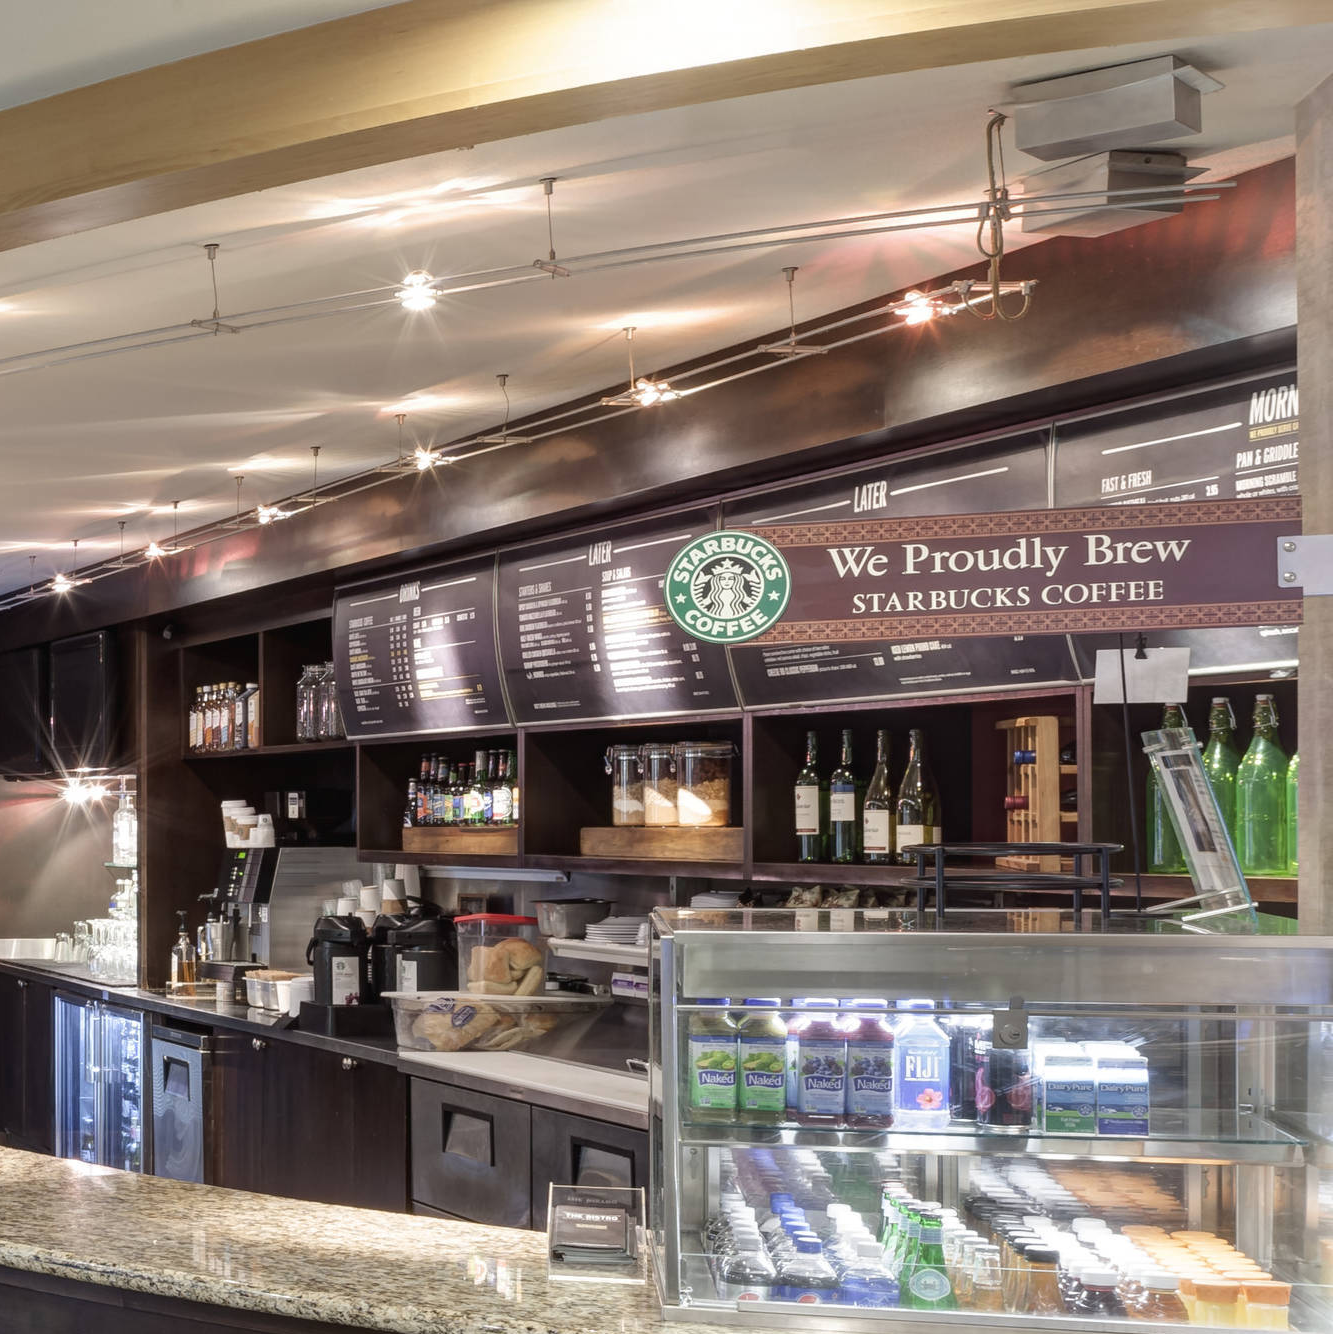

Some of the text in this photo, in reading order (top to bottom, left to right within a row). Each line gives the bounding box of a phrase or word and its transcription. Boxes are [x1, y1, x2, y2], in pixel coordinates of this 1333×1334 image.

[1249, 384, 1299, 425] MORN
[1236, 442, 1299, 469] PAN & GRIDDLE
[1101, 470, 1152, 493] FAST & FRESH
[854, 481, 887, 513] LATER
[588, 541, 612, 566] LATER
[673, 537, 783, 584] STARBUCKS
[827, 534, 1192, 579] We Proudly Brew
[852, 580, 1164, 614] STARBUCKS COFFEE
[685, 609, 768, 636] COFFEE
[702, 1072, 735, 1083] Naked
[905, 1055, 942, 1078] FIJI
[748, 1074, 782, 1086] Naked
[807, 1077, 842, 1089] Naked
[857, 1078, 892, 1090] Naked
